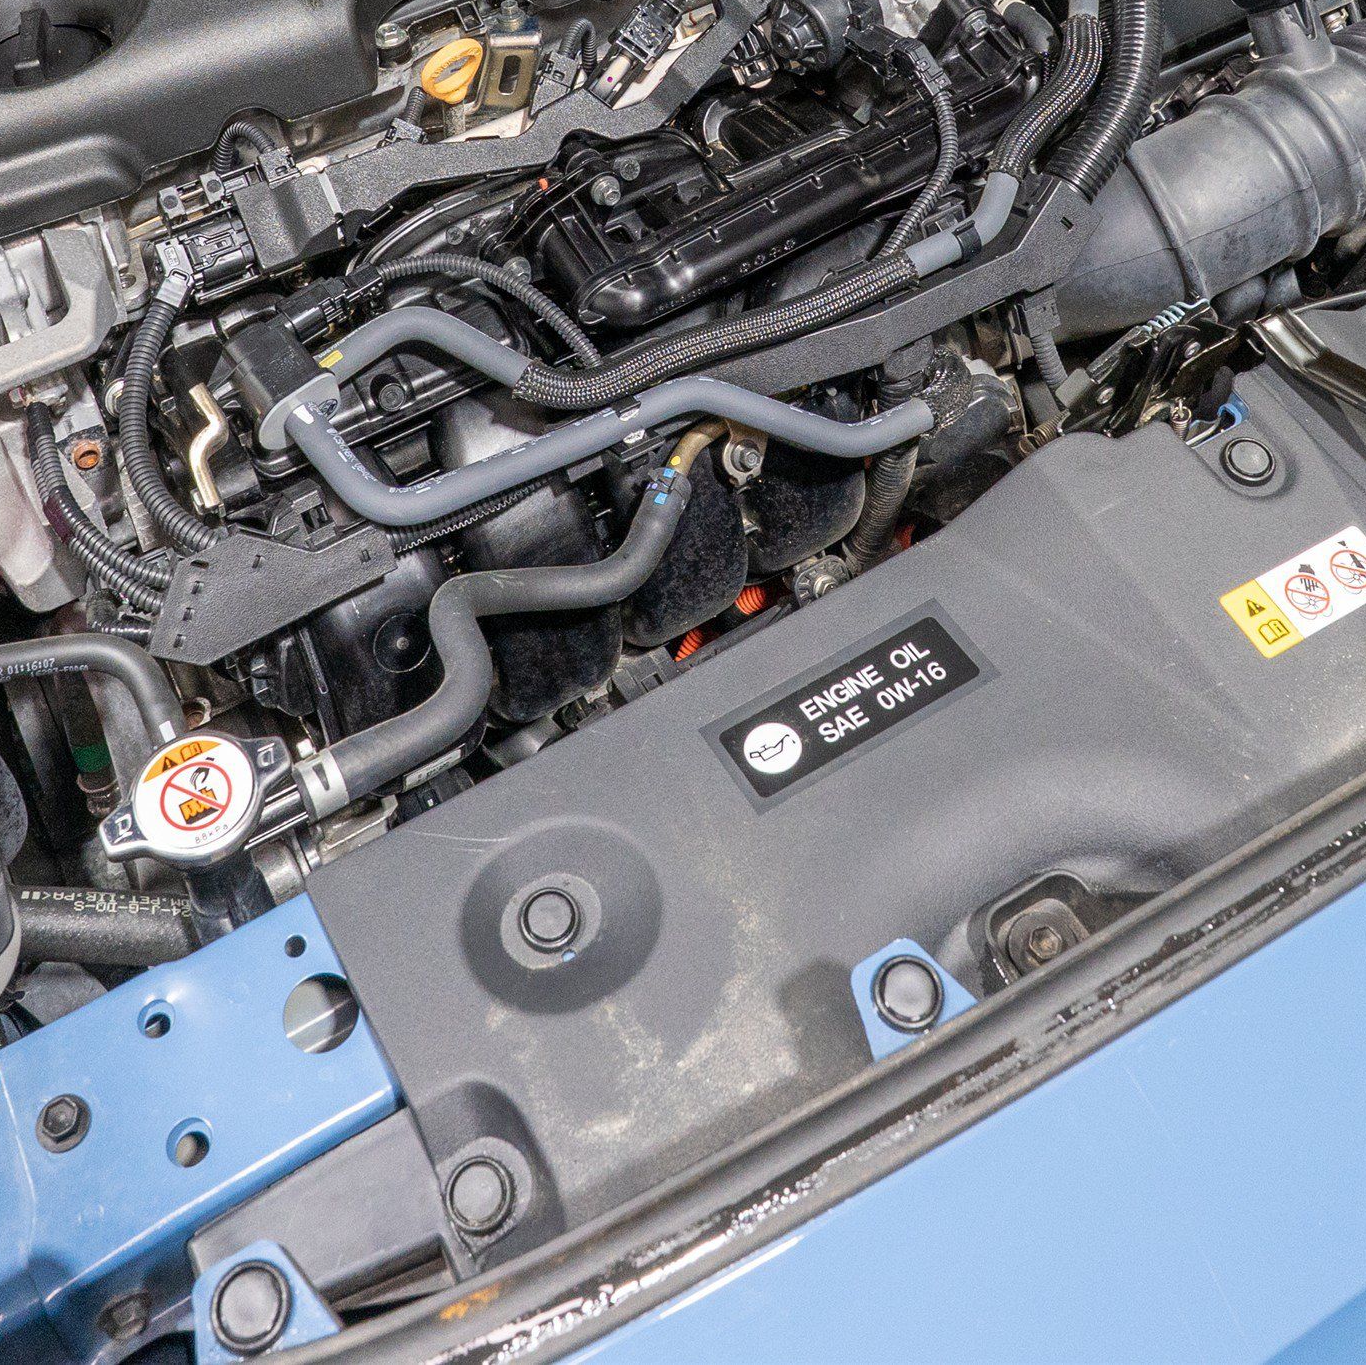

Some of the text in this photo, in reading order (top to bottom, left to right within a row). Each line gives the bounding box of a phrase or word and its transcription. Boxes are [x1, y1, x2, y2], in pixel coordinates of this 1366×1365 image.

[7, 657, 56, 676] 01:16:07
[798, 641, 931, 722] ENGINE OIL
[817, 660, 948, 743] SAE 0W-16
